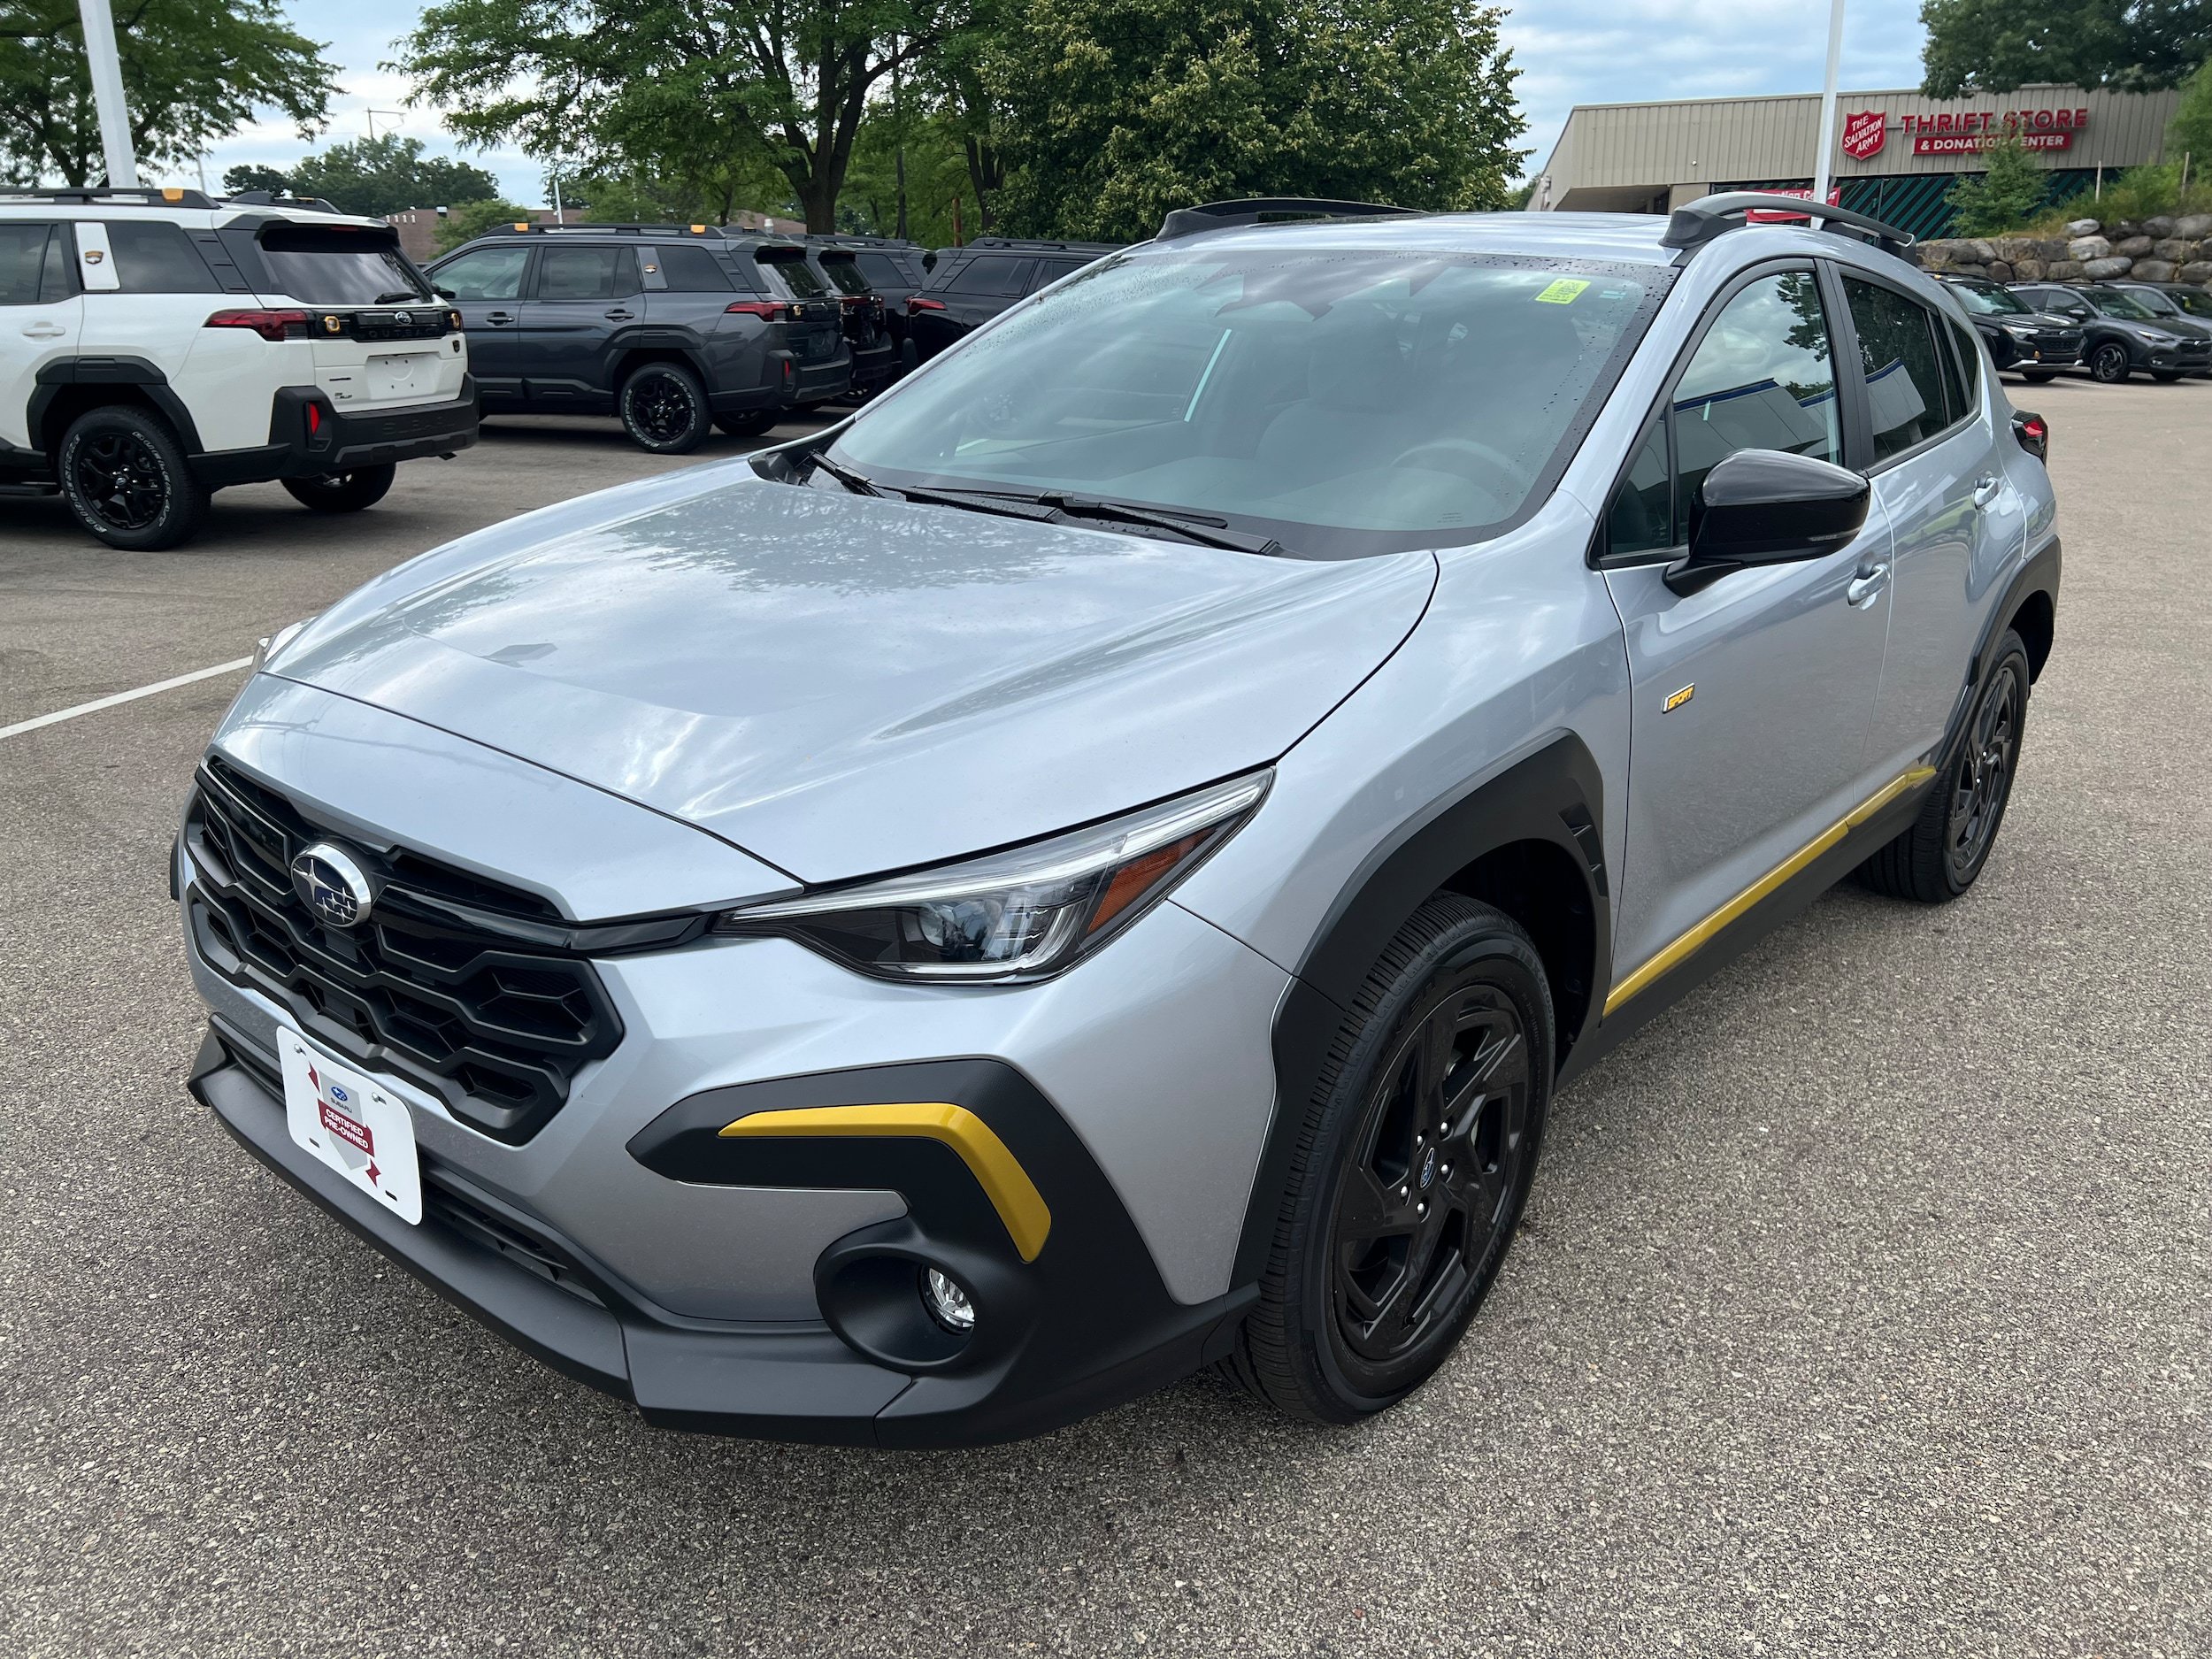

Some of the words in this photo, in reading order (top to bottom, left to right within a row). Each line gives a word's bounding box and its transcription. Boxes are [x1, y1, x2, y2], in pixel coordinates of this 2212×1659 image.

[1844, 117, 1883, 148] SALVATION
[1851, 115, 1869, 131] THE
[1901, 111, 1994, 134] THRIFT
[2002, 108, 2088, 129] STORE
[1855, 130, 1880, 154] ARMY
[1921, 140, 1930, 150] &
[1667, 686, 1694, 710] SPORT
[330, 1097, 352, 1113] SUBARU
[324, 1116, 369, 1149] PRE-OWNED
[326, 1109, 364, 1137] CERTIFIED
